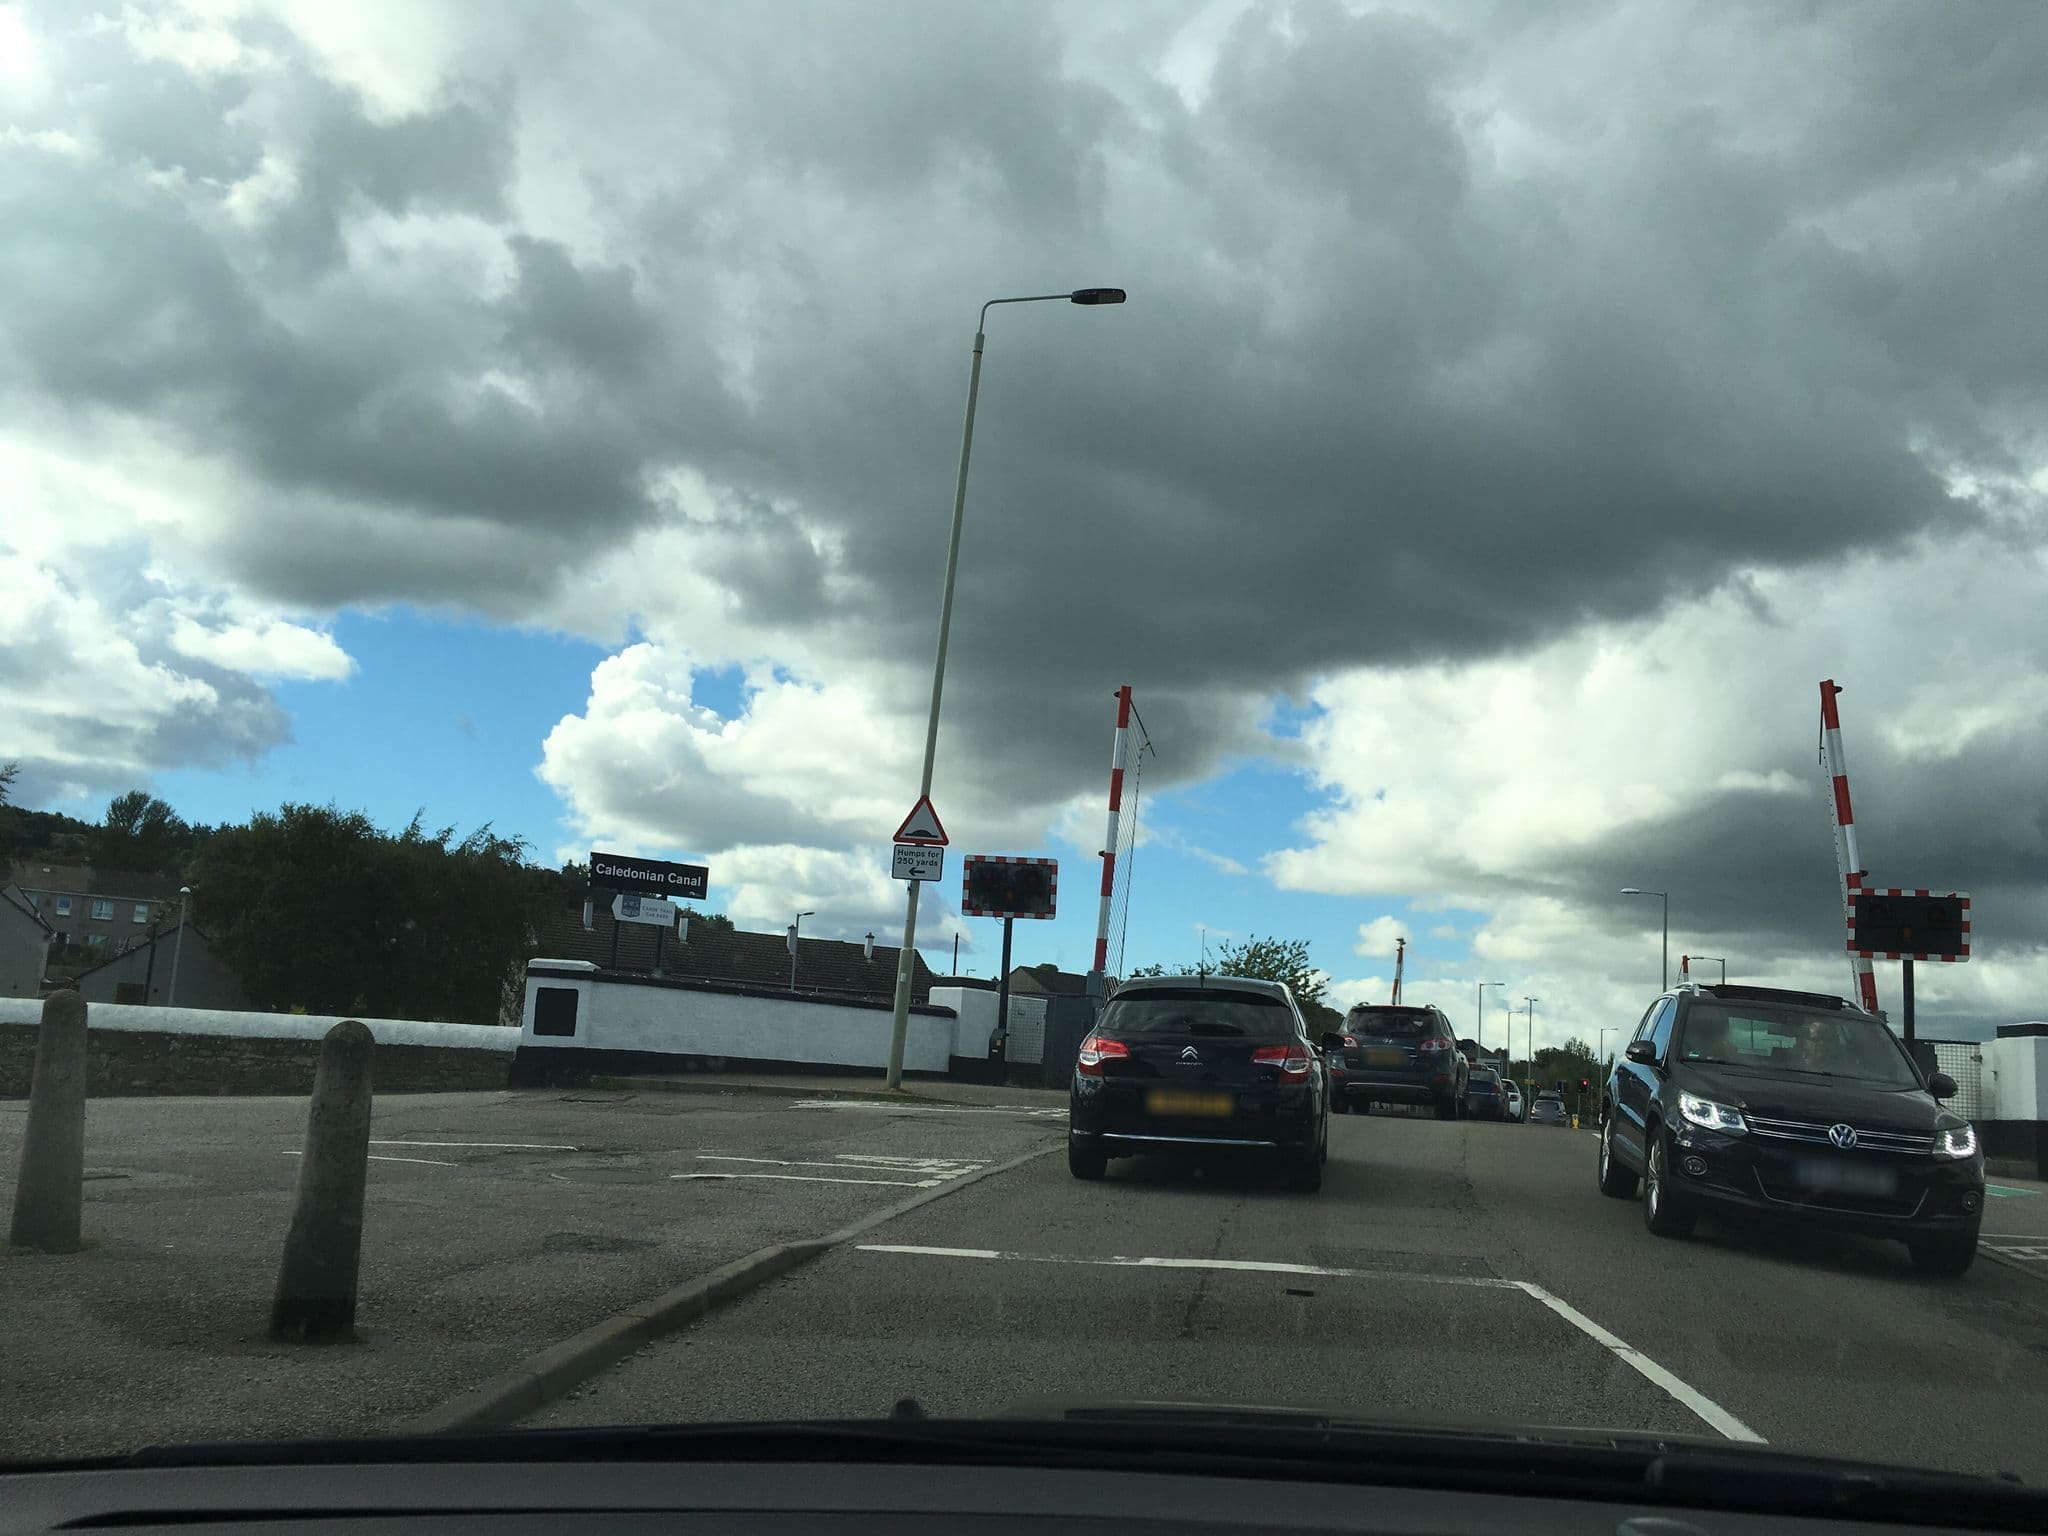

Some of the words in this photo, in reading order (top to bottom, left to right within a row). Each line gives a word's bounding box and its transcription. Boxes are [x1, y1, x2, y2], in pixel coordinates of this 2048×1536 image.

[897, 848, 925, 857] Humps
[927, 850, 940, 858] for
[897, 857, 914, 865] 250
[596, 863, 664, 882] Caledonian
[667, 872, 701, 887] Canal
